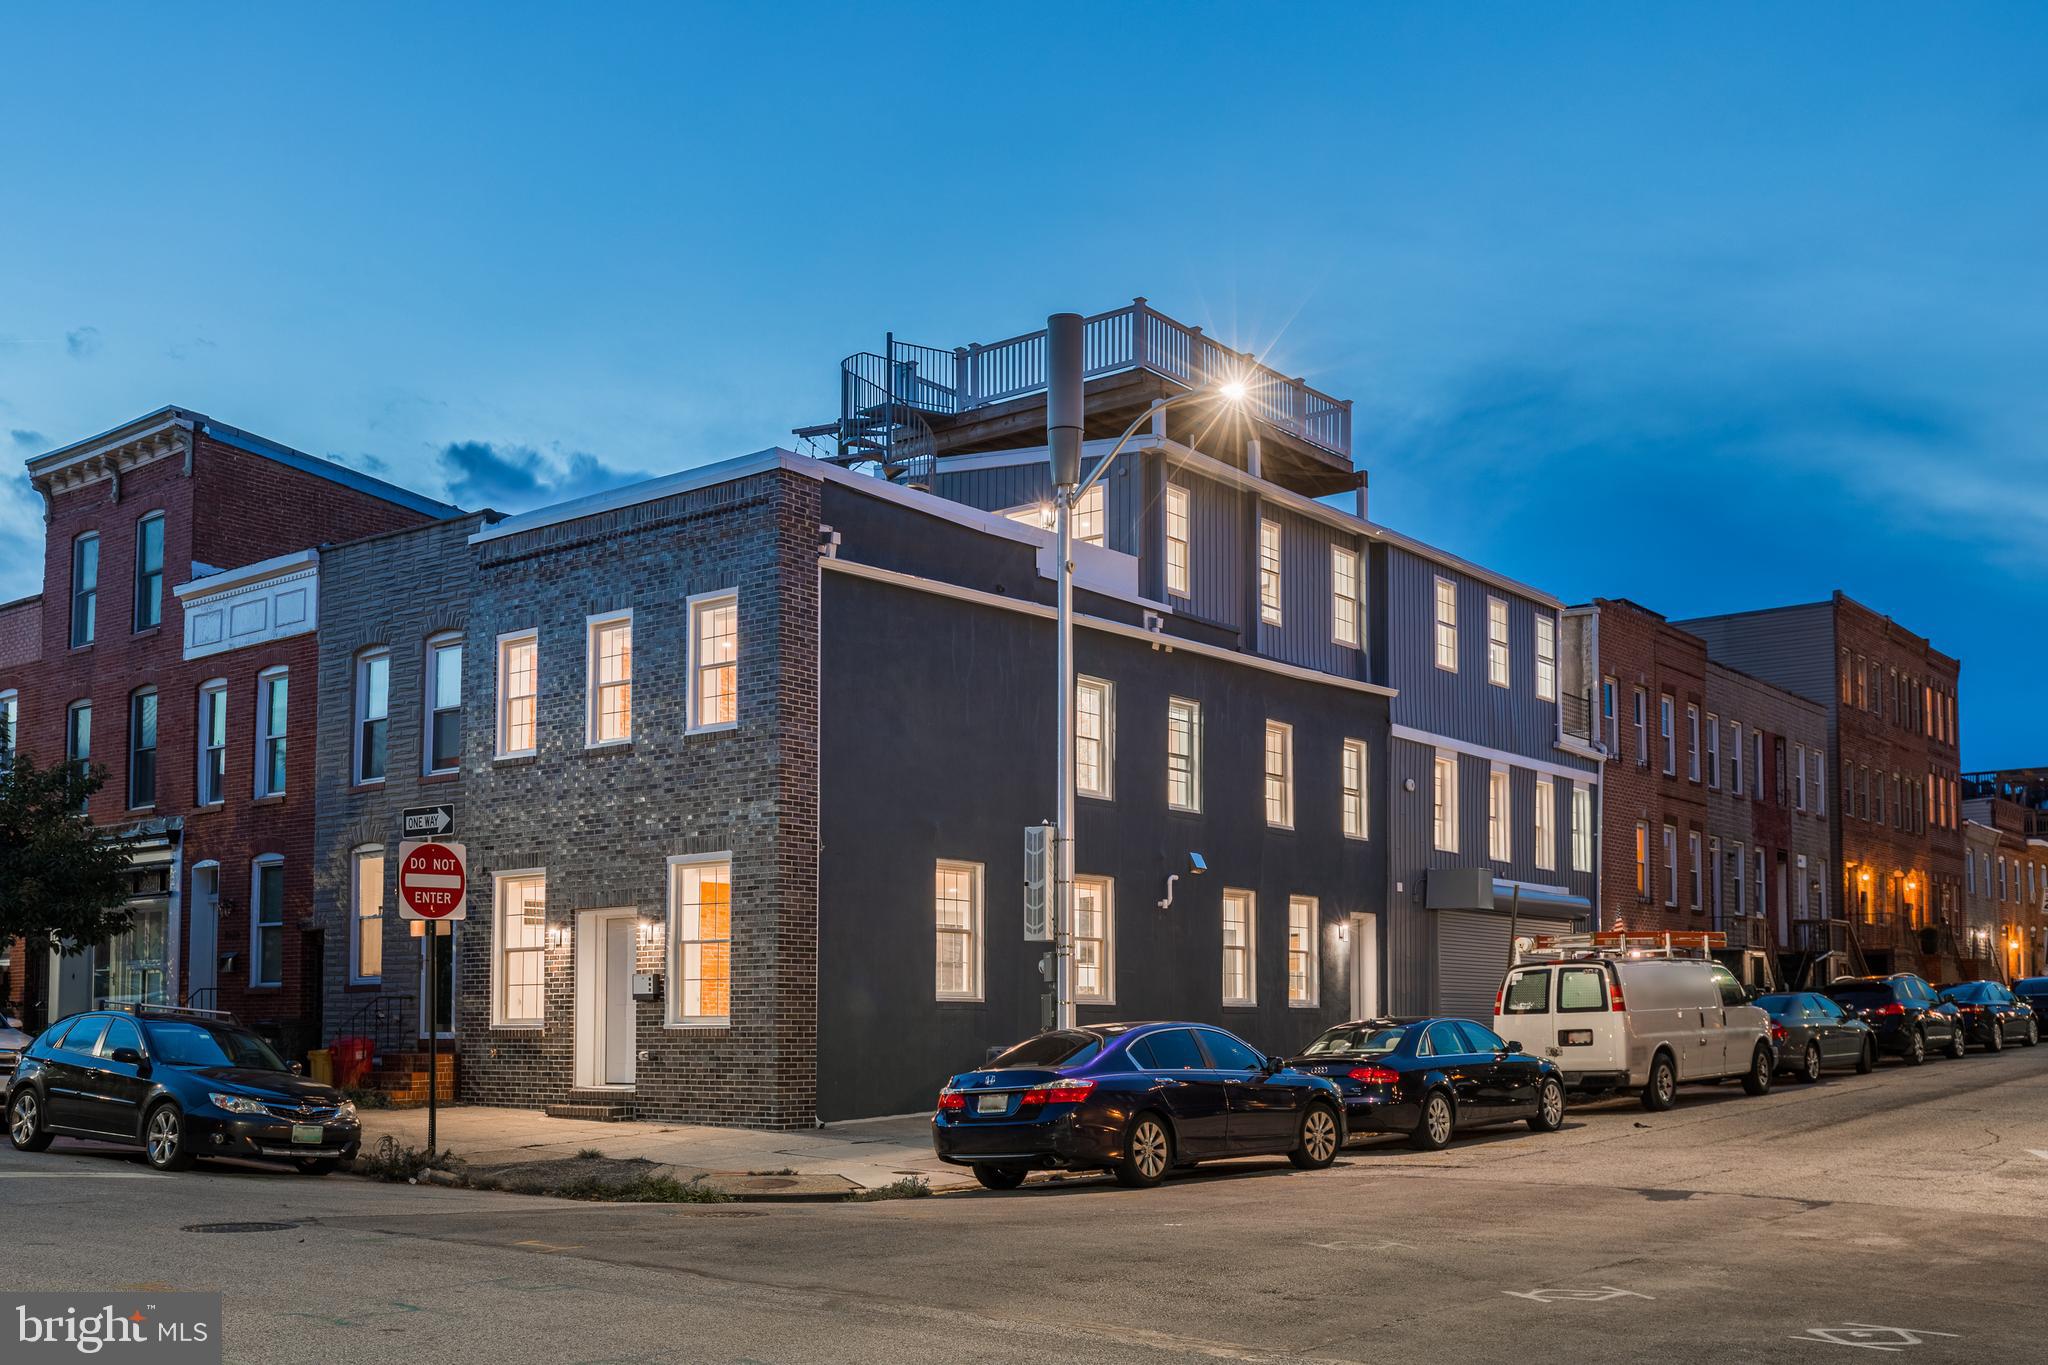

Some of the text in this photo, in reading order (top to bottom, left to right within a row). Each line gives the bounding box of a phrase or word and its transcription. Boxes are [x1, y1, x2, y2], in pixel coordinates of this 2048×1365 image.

[408, 814, 439, 829] ONE WAY
[410, 857, 455, 871] DO NOT
[415, 891, 451, 904] ENTER
